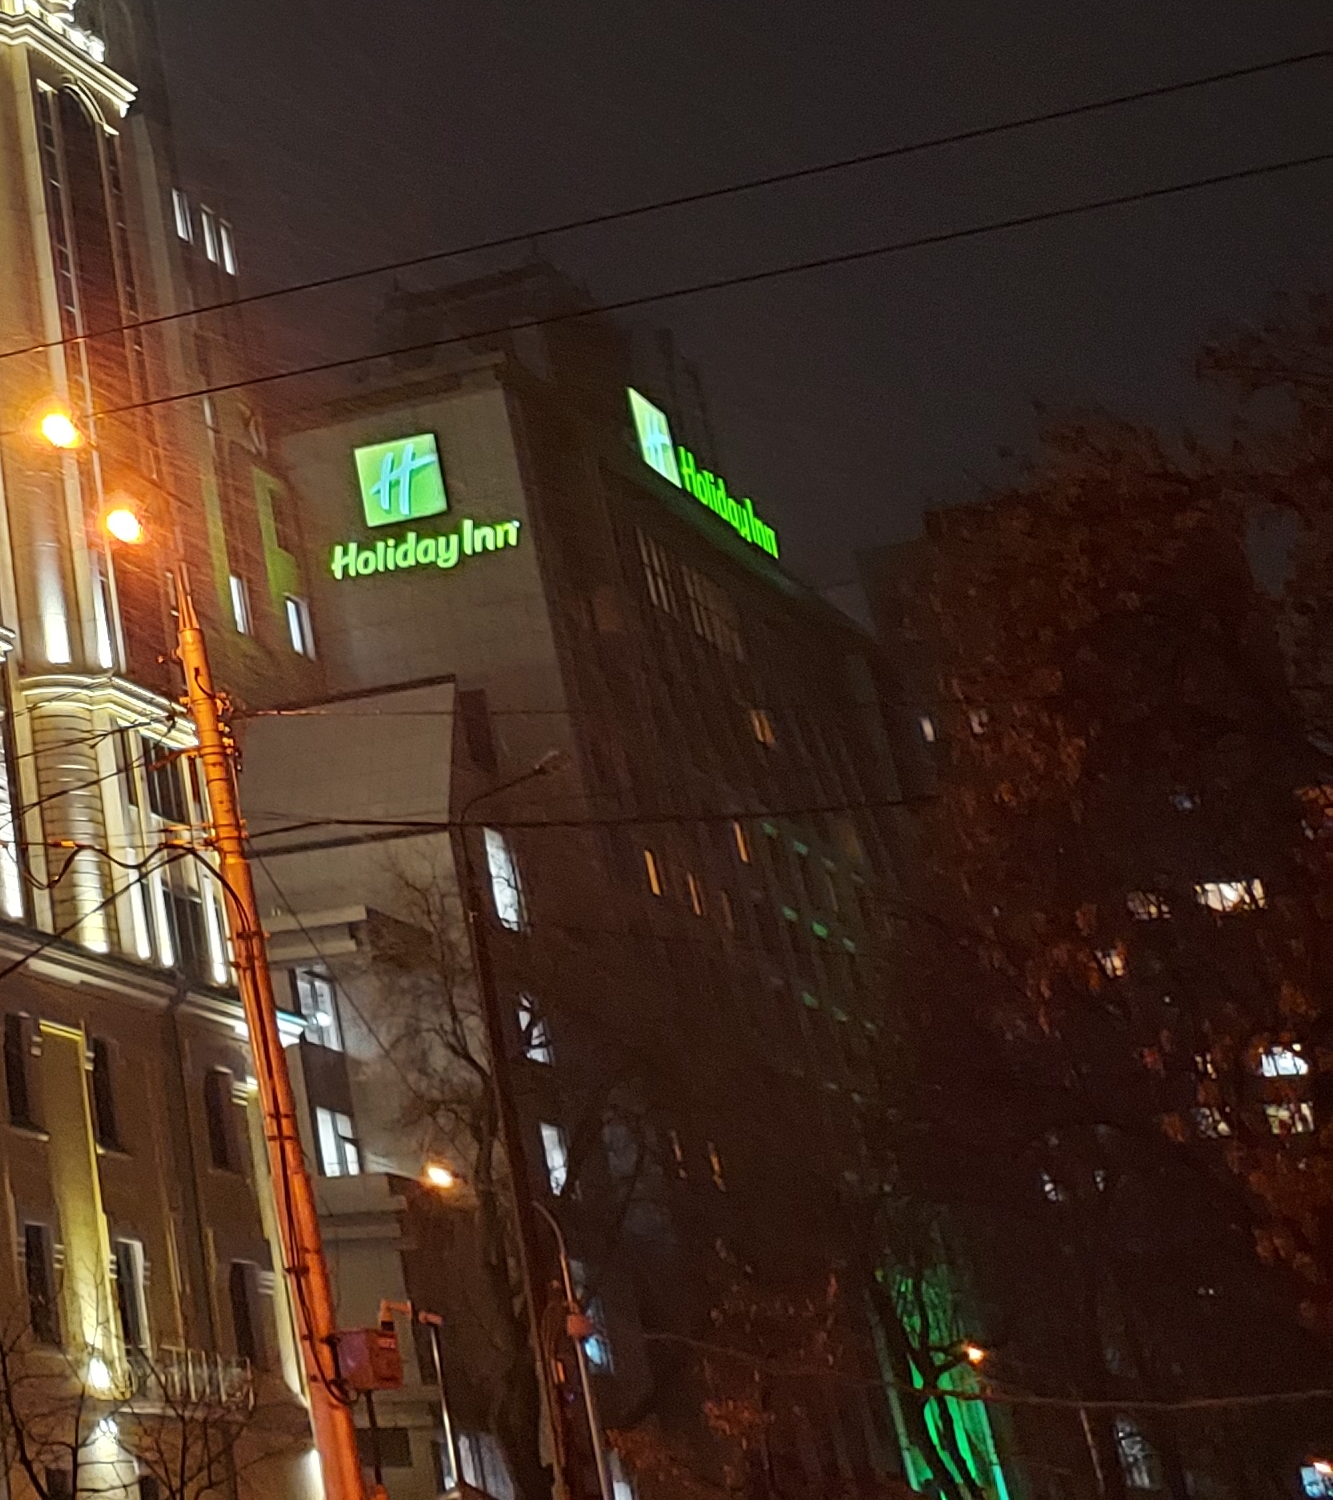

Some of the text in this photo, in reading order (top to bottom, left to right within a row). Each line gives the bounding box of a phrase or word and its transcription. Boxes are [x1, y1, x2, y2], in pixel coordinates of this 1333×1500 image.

[677, 445, 752, 543] Holiday
[331, 518, 520, 580] Holiday Inn
